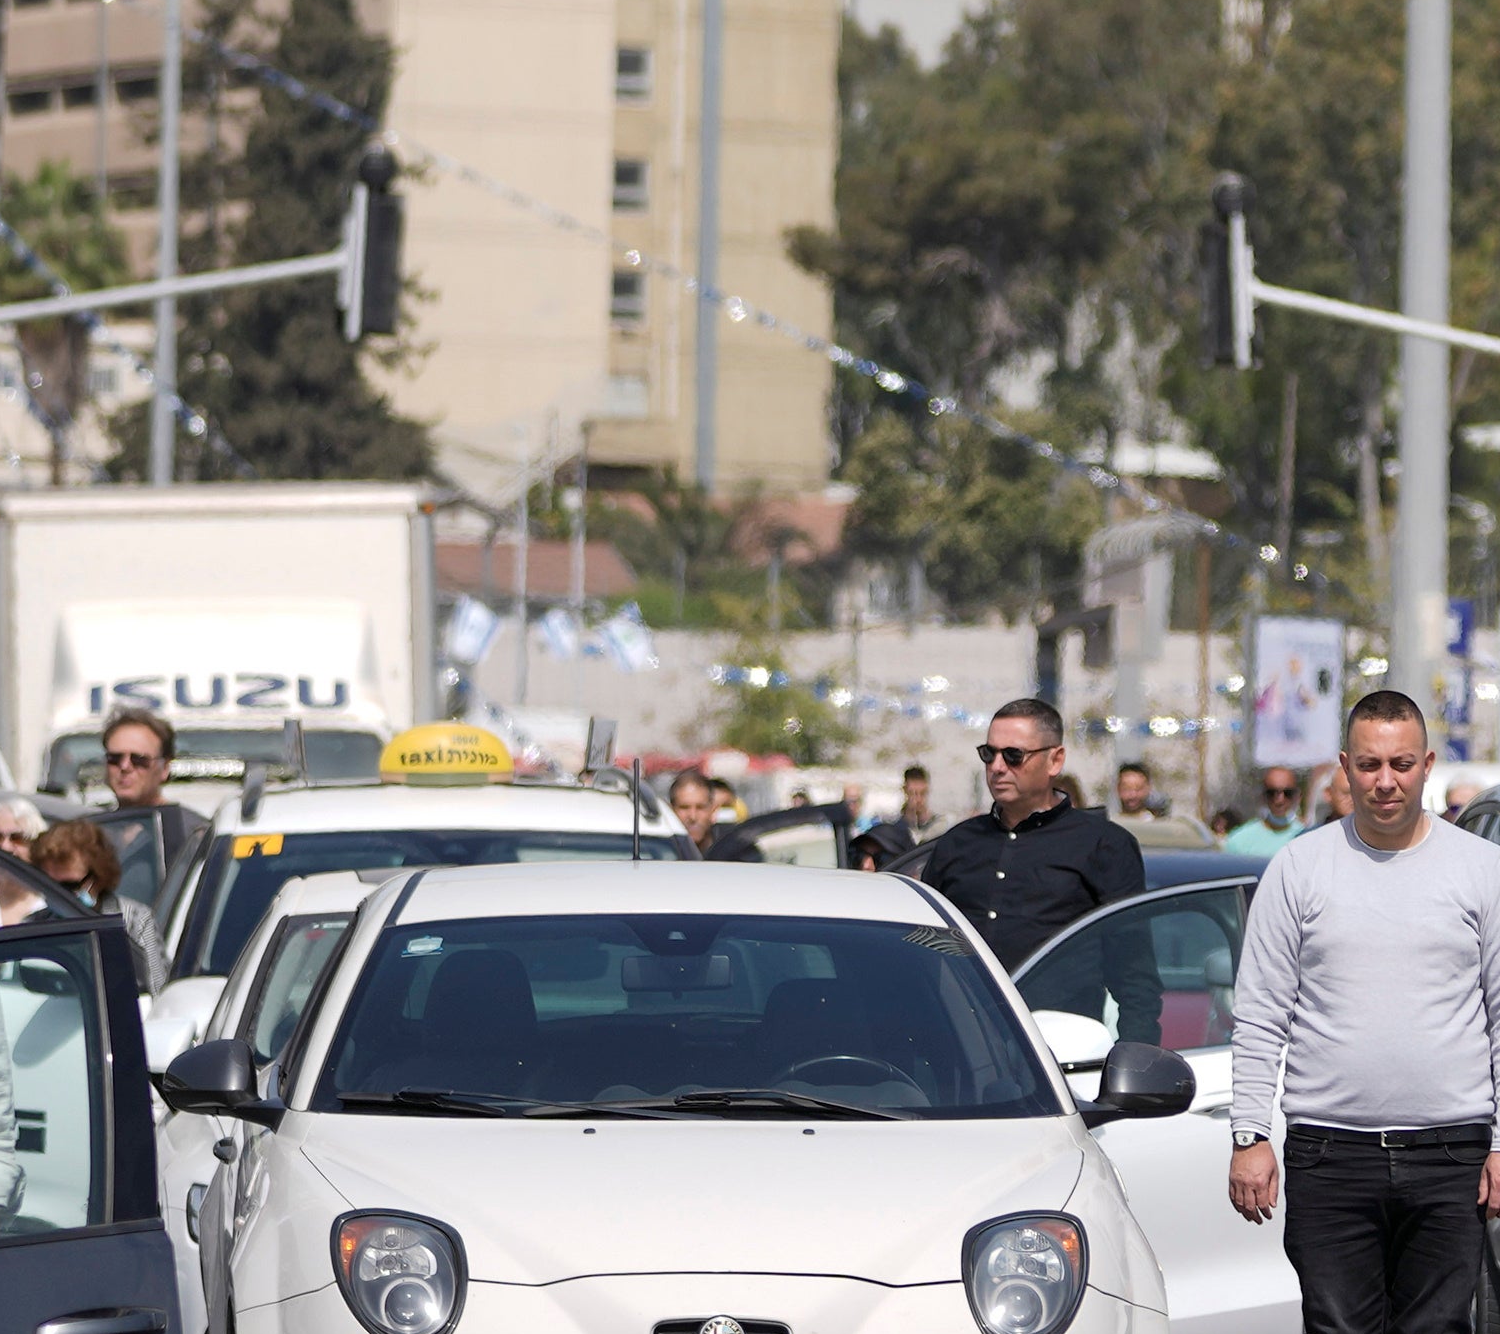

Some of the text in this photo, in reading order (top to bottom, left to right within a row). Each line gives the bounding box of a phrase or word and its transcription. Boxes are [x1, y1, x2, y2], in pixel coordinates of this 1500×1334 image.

[90, 674, 349, 714] ISUZU
[400, 744, 442, 766] taxi
[448, 747, 498, 766] מונית
